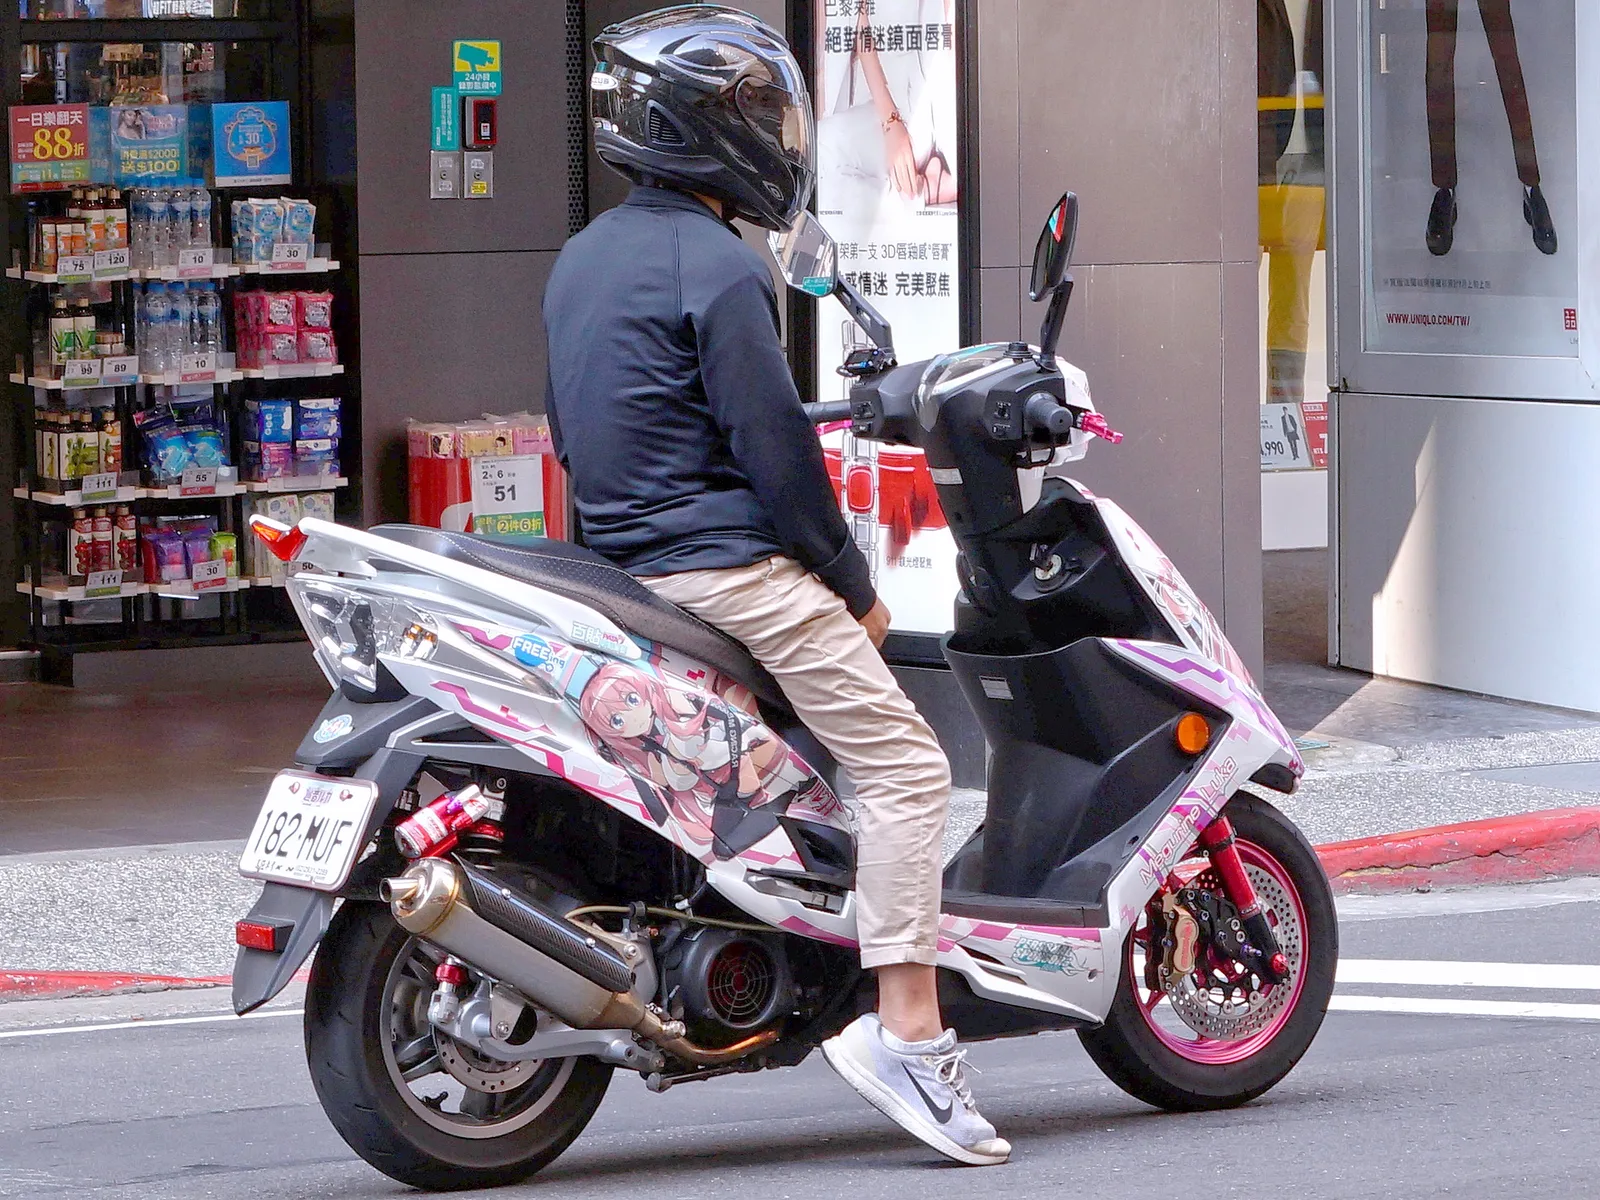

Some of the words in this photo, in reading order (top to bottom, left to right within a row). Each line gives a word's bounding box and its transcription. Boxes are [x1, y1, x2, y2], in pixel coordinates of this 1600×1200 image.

[825, 23, 953, 53] 絕對情迷鏡面唇膏
[17, 111, 83, 126] 一日樂翻天
[192, 255, 204, 264] 10
[286, 249, 298, 258] 30
[895, 271, 950, 297] 完美聚焦
[1386, 313, 1470, 326] WWW.UNIQLO.COM/TW/
[114, 364, 127, 373] 89
[195, 359, 206, 369] 10
[1260, 440, 1284, 457] ,990
[195, 474, 207, 482] 55
[494, 484, 516, 502] 51
[206, 567, 218, 575] 30
[1201, 756, 1237, 801] Luka
[1138, 804, 1201, 886] Megurine
